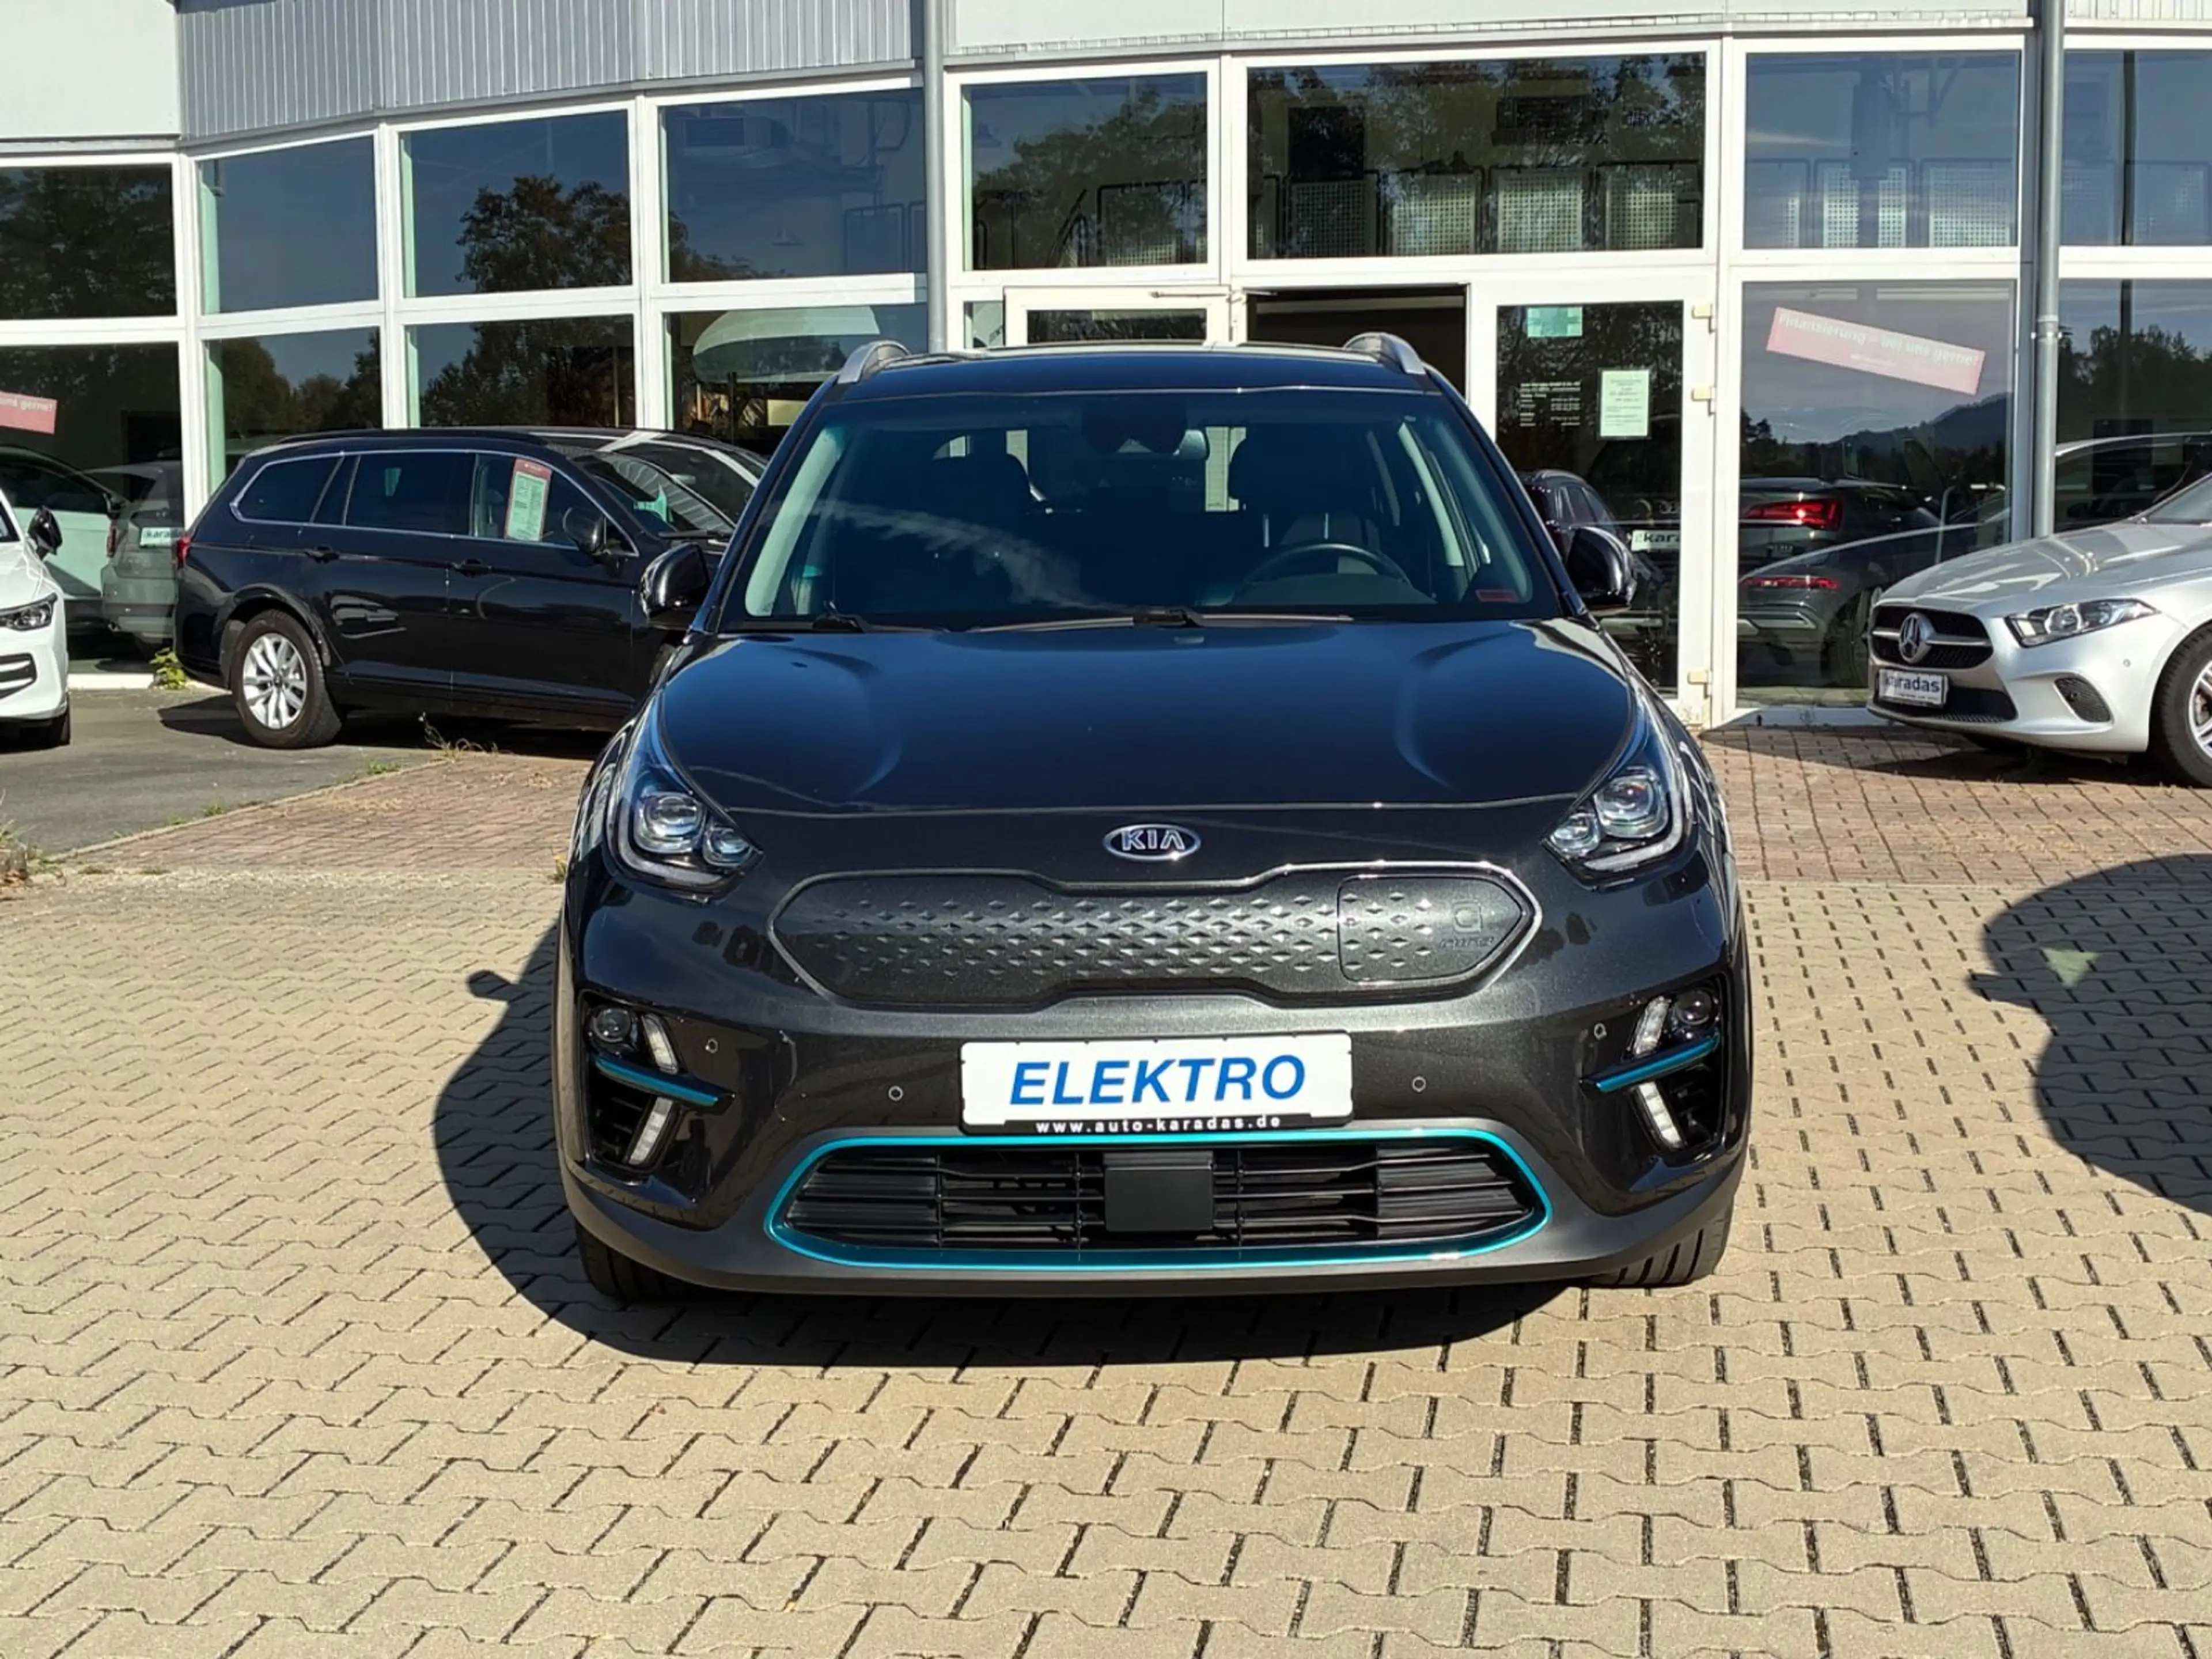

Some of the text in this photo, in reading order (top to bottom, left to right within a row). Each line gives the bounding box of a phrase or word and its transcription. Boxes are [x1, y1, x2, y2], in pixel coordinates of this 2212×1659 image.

[1121, 829, 1185, 851] KIA
[1010, 1055, 1305, 1105] ELEKTRO
[1036, 1115, 1281, 1133] www.auto-karadas.de
